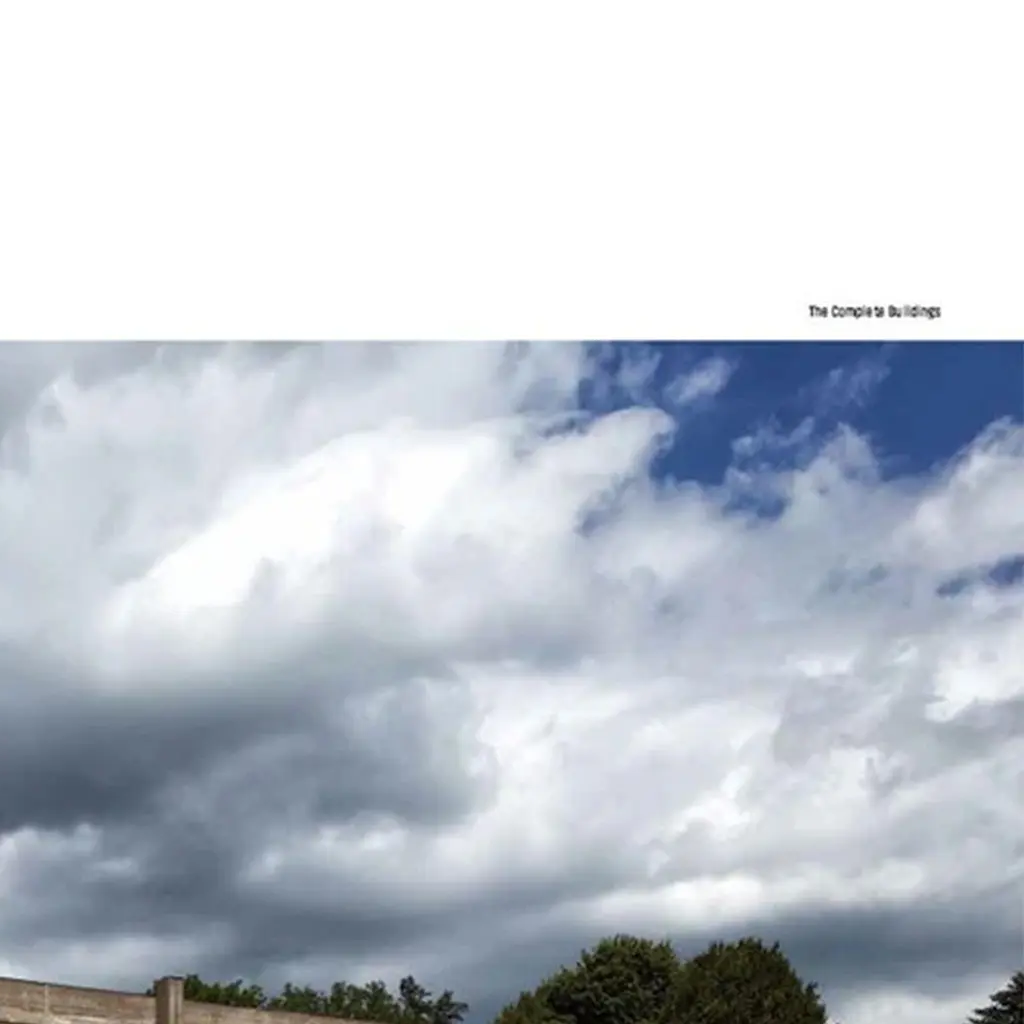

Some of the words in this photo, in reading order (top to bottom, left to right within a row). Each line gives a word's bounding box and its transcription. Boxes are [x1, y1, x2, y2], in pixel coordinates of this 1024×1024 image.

[808, 304, 829, 318] The
[831, 304, 885, 320] Complete
[888, 304, 942, 320] Buildings
